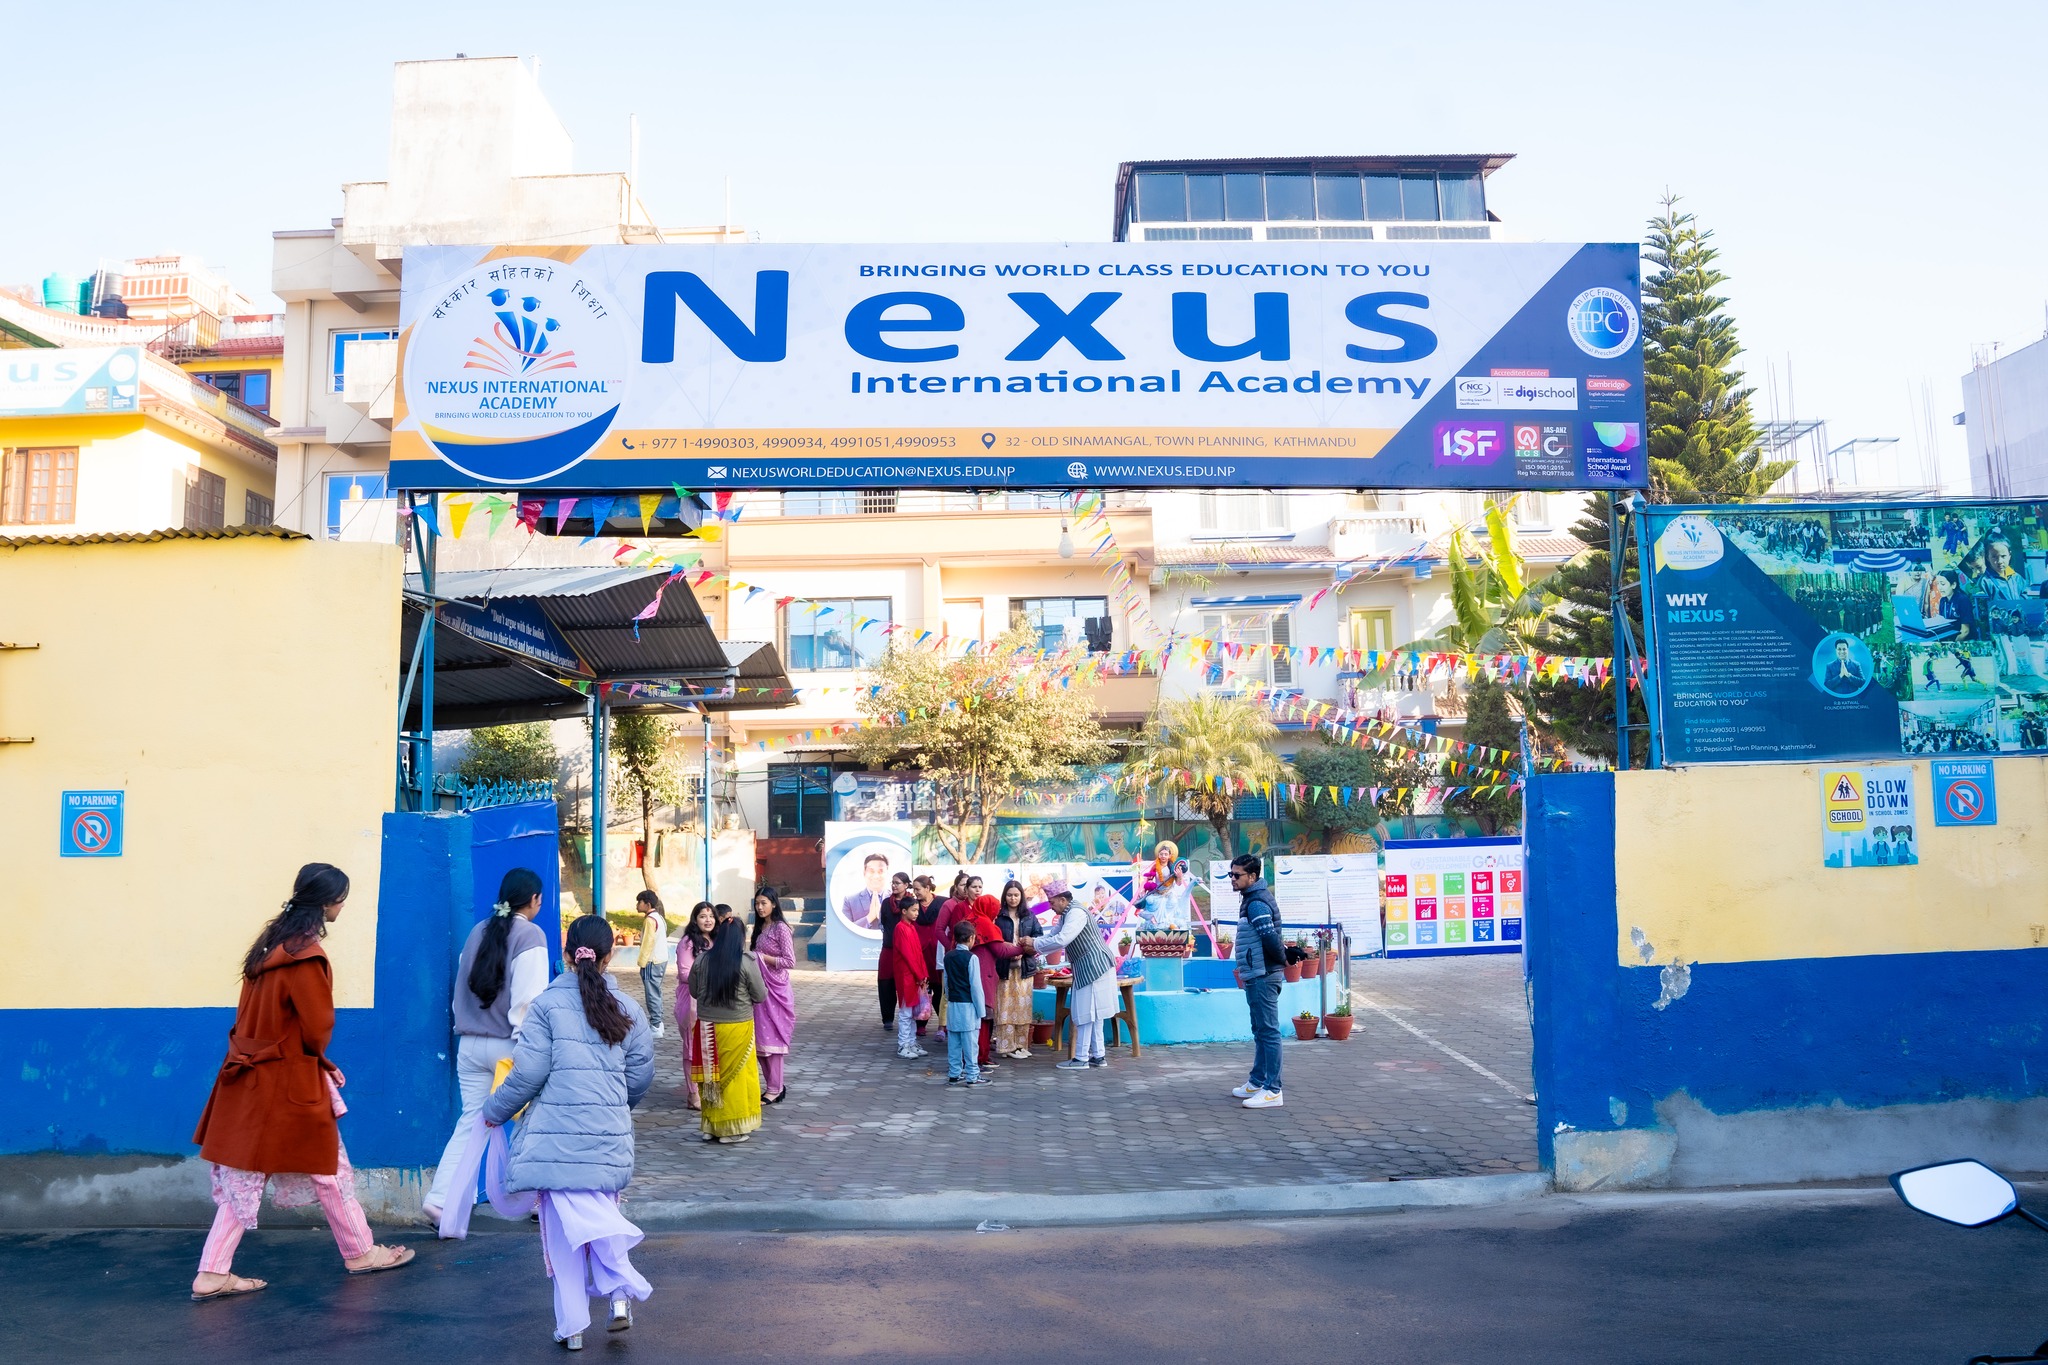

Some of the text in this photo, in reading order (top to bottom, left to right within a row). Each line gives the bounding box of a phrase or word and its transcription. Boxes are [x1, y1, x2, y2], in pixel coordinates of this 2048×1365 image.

[859, 264, 1431, 278] BRINGING WORLD CLASS EDUCATION TO YOU
[1572, 289, 1632, 311] An IPC Franchise
[641, 269, 1438, 364] Nexus
[1578, 310, 1624, 334] IPC
[1570, 322, 1636, 356] International Preschool Curriculum
[1493, 369, 1525, 377] Accredited
[427, 380, 608, 394] NEXUS INTERNATIONAL
[851, 369, 1432, 400] International Academy
[1588, 380, 1625, 390] Cambridge
[1515, 384, 1576, 401] digischool
[478, 396, 558, 410] ACADEMY
[522, 411, 564, 419] EDUCATION
[1543, 426, 1567, 434] JAS-ANZ
[651, 438, 677, 450] 977
[681, 437, 759, 451] 1-4990303,
[762, 437, 827, 451] 4990934,
[1005, 436, 1021, 447] 32
[1031, 436, 1060, 447] OLD
[1062, 436, 1152, 449] SINAMANGAL,
[1154, 436, 1195, 447] TOWN
[1198, 436, 1268, 448] PLANNING,
[1273, 436, 1357, 447] KATHMANDU
[1443, 429, 1497, 456] ISF
[732, 465, 1236, 479] NEXUSWORLDEDUCATION@NEXUS.EDU.NP WWW.NEXUS.EDU.NP
[1666, 592, 1709, 607] WHY
[1667, 608, 1738, 623] NEXUS ?
[508, 634, 519, 648] level
[518, 638, 526, 652] and
[1673, 692, 1713, 701] "BRINGING
[1743, 690, 1767, 698] CLASS
[1673, 699, 1717, 708] EDUCATION
[1729, 698, 1749, 706] YOU"
[1692, 727, 1736, 735] 977-1-4990303
[1693, 736, 1735, 745] nexus.edu.np
[1750, 744, 1780, 753] Planning,
[1780, 743, 1817, 751] Kathmandu
[1938, 764, 1987, 775] NO PARKING
[1866, 779, 1907, 795] SLOW
[68, 795, 118, 806] NO PARKING
[1867, 793, 1909, 809] DOWN
[1830, 810, 1862, 822] SCHOOL
[1426, 855, 1472, 864] SUSTAINABLE
[1472, 854, 1523, 869] GOALS
